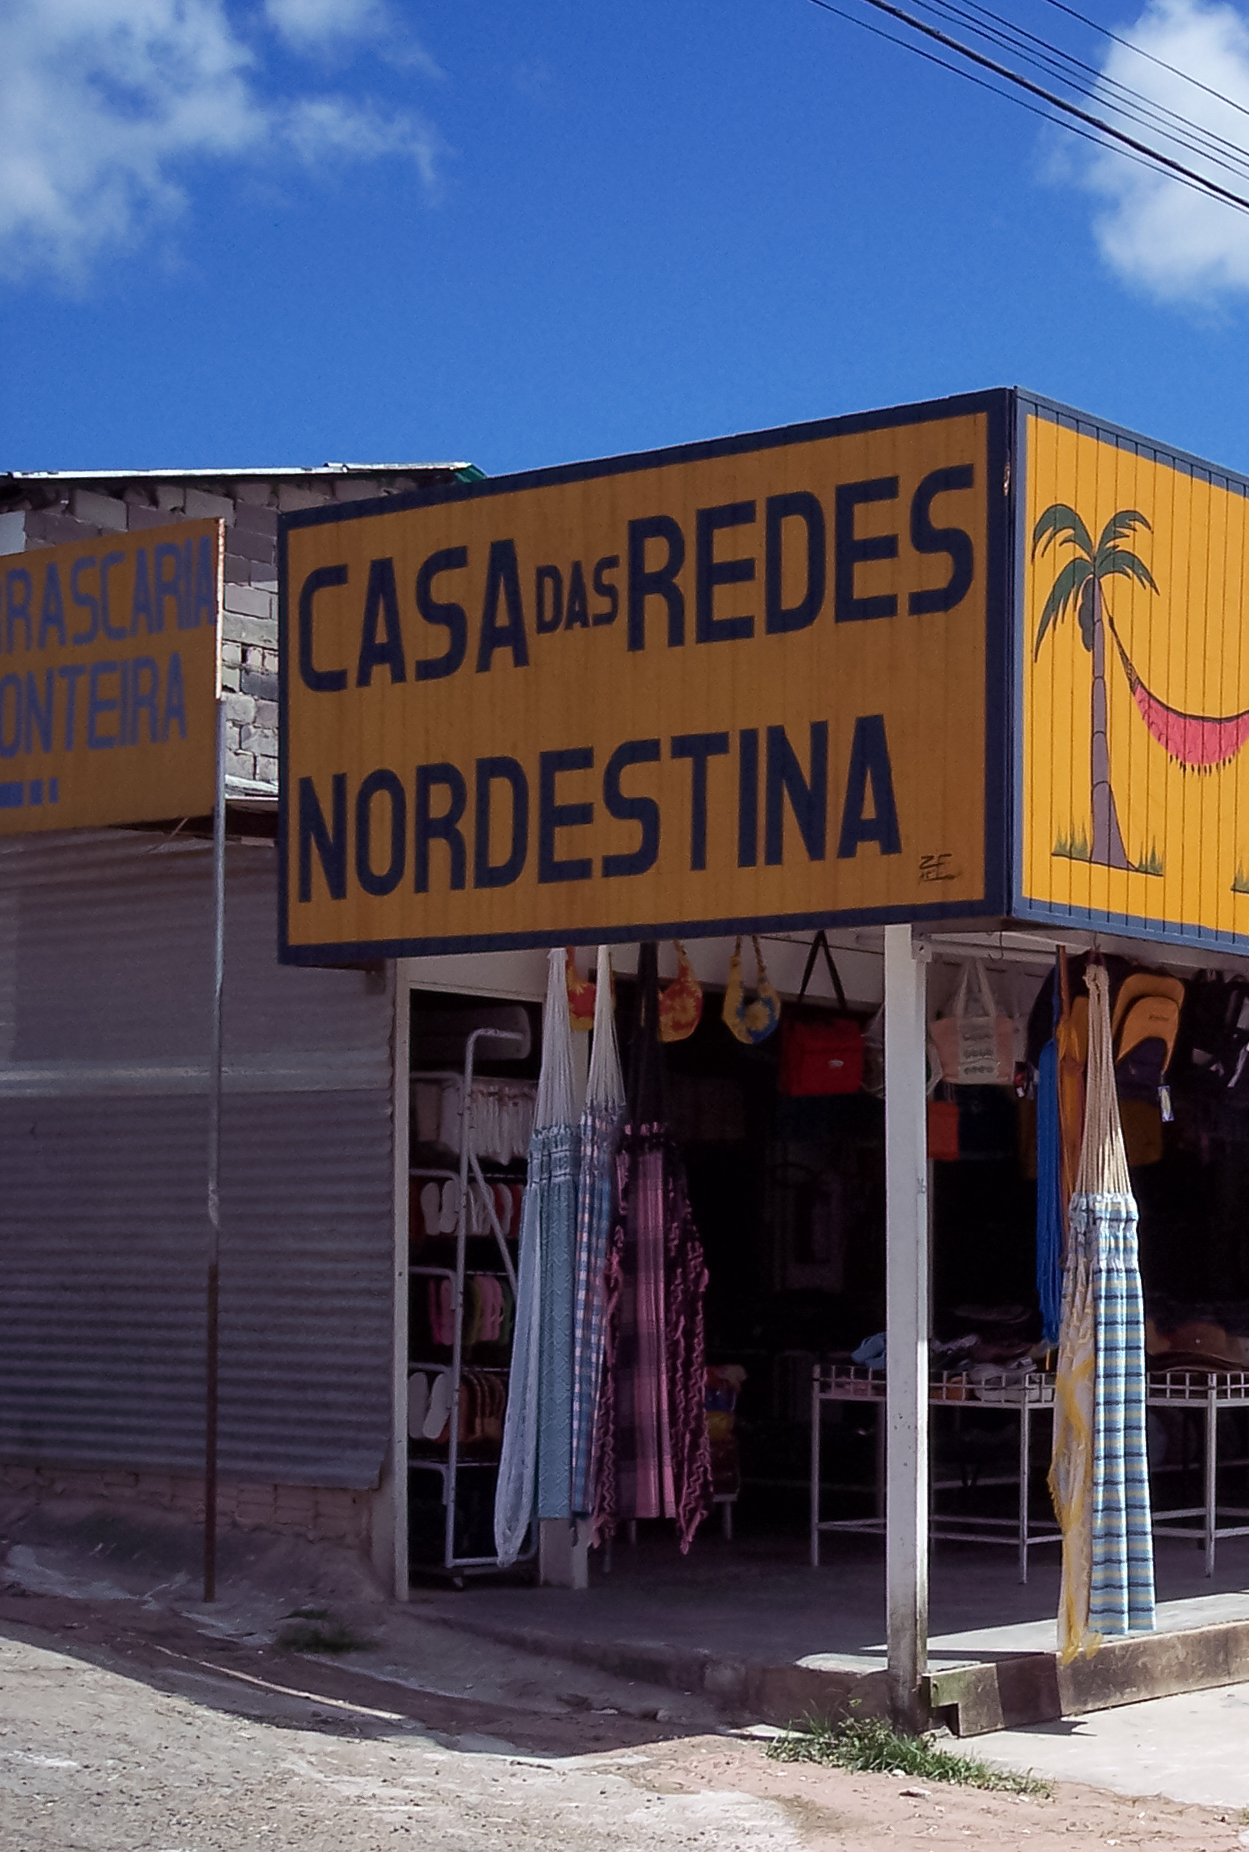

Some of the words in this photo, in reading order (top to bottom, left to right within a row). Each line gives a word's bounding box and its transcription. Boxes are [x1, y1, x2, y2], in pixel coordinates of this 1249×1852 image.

[0, 536, 217, 654] RASCARIA
[299, 539, 530, 692] CASA
[536, 555, 620, 635] DAS
[627, 464, 976, 652] REDES
[299, 714, 903, 902] NORDESTINA
